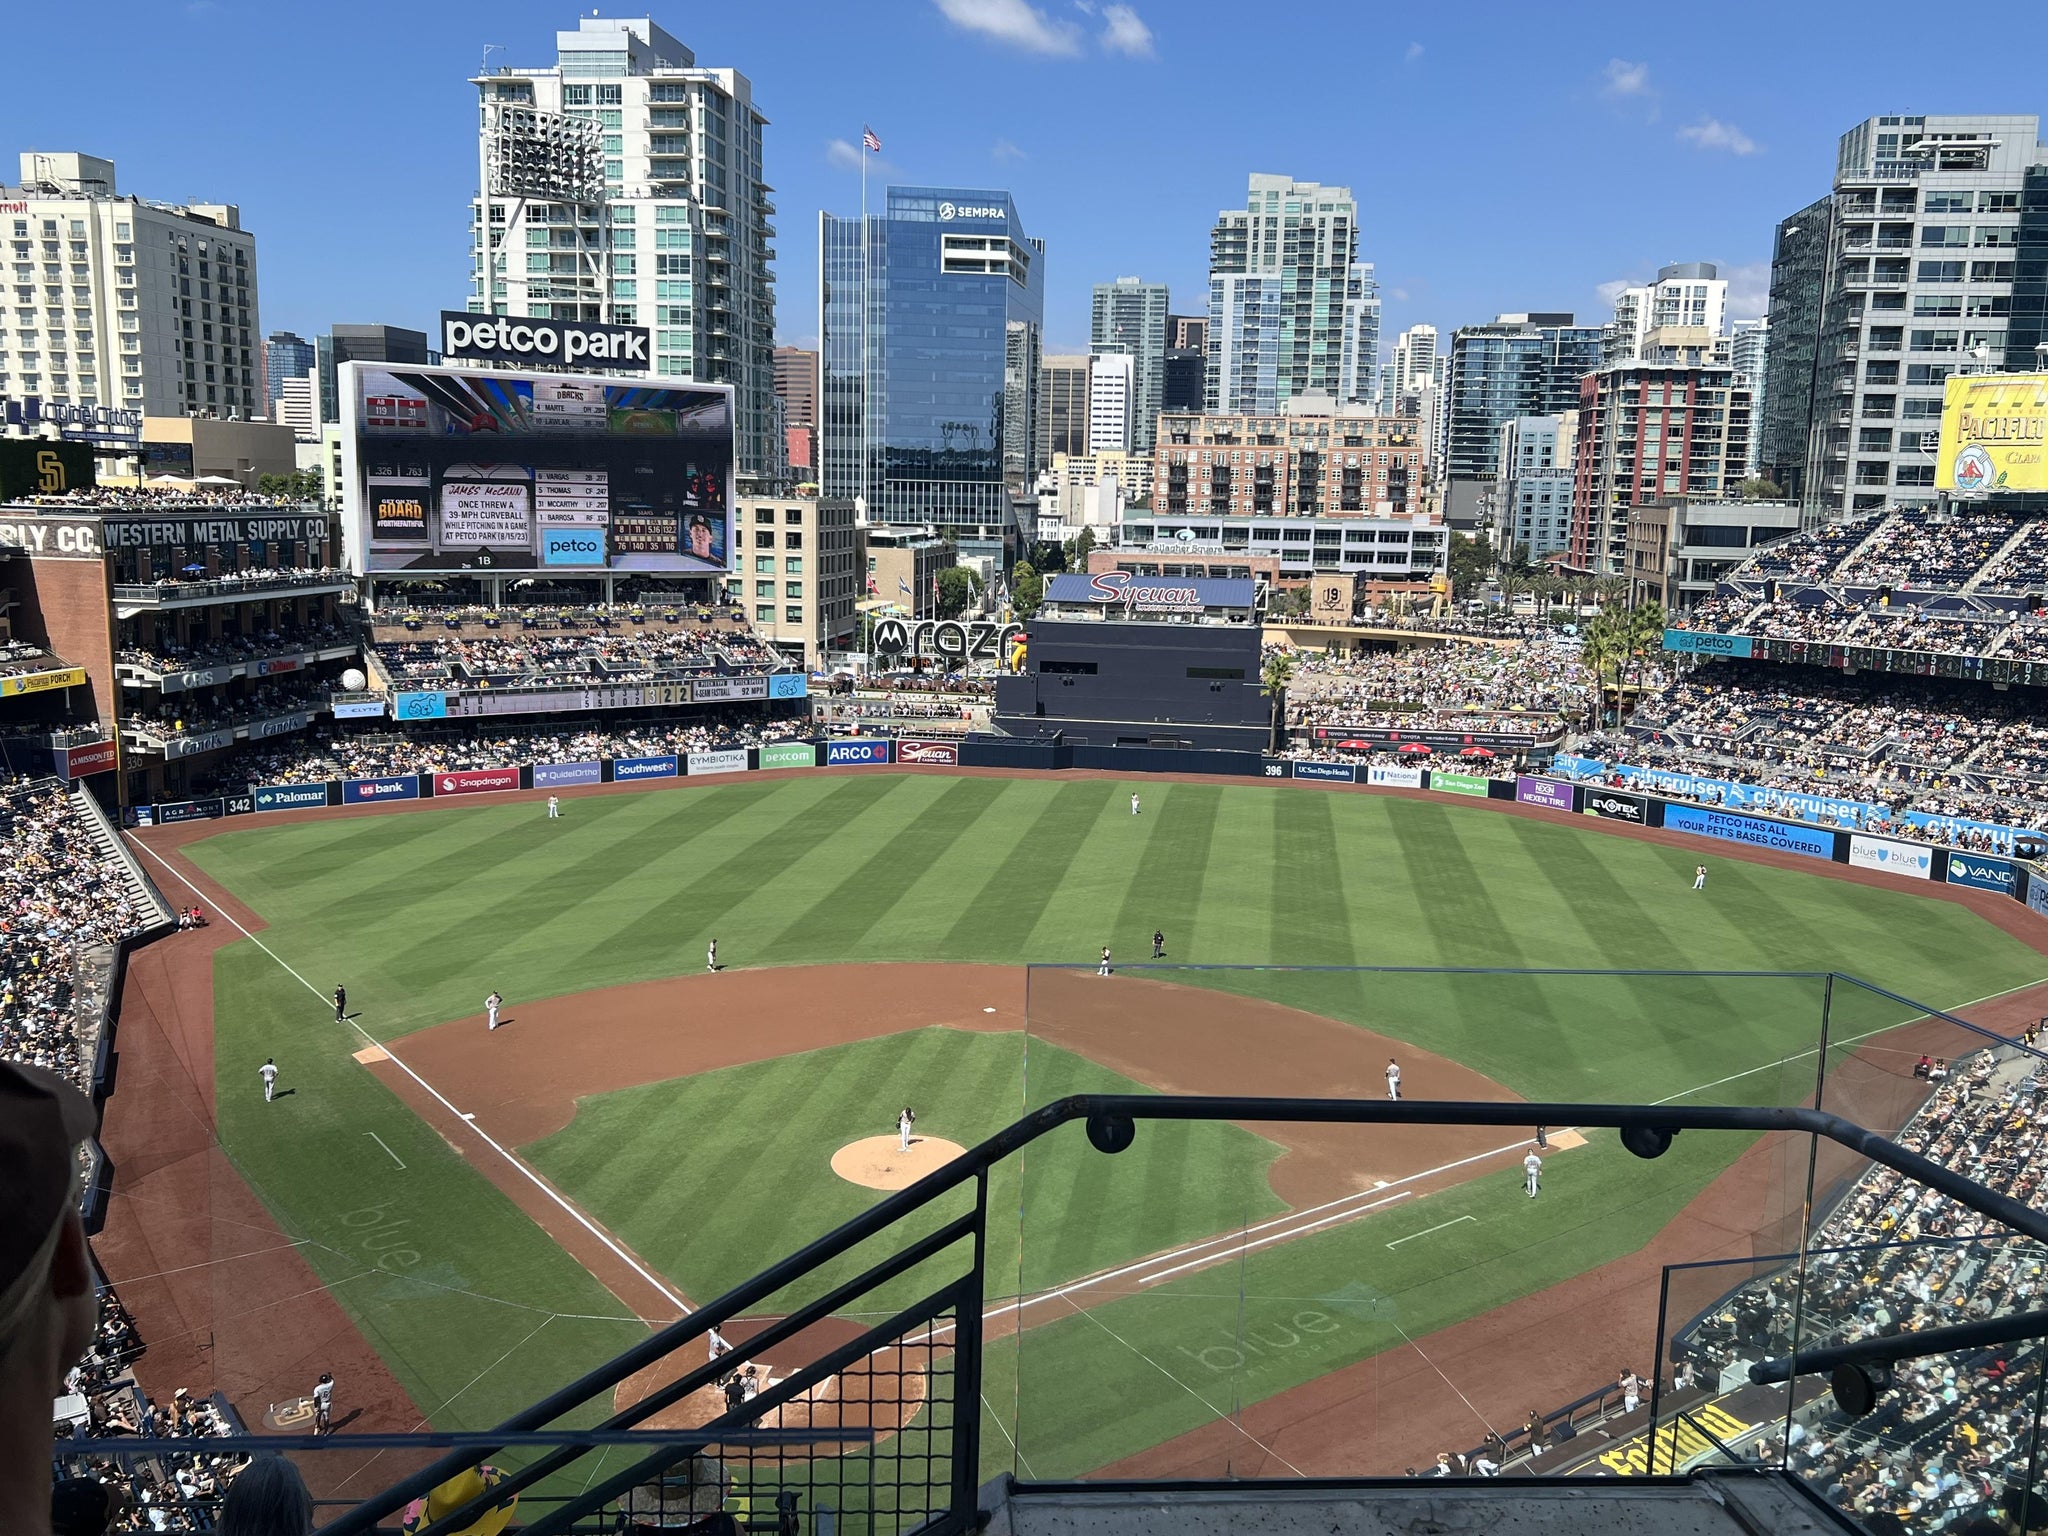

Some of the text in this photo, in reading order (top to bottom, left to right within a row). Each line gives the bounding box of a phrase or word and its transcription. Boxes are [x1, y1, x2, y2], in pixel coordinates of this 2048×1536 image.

[957, 207, 1005, 219] SEMPRA
[446, 317, 646, 363] petco park
[376, 407, 387, 415] 119
[408, 408, 416, 416] 31
[449, 487, 480, 496] JAMES
[547, 500, 578, 508] MCCARTHY
[379, 503, 422, 519] BOARD
[449, 511, 523, 519] 39-MPH CURVEBALL
[466, 522, 496, 530] PITCHING
[497, 522, 503, 530] IN
[505, 522, 509, 530] A
[510, 522, 527, 530] GAME
[104, 519, 328, 546] WESTERN METAL SUPPLY CO.
[445, 532, 528, 541] AT PETCO PARK (8/15/23)
[57, 526, 101, 553] CO.
[551, 539, 597, 554] petco
[1146, 544, 1223, 554] Gallagher Square
[478, 557, 491, 565] 1B
[1088, 570, 1200, 611] Sycuan
[1326, 588, 1338, 600] 19
[912, 620, 1023, 658] razr
[1696, 635, 1733, 650] petco
[1764, 640, 1769, 648] 0
[1804, 644, 1808, 652] 2
[1844, 647, 1849, 656] 0
[1764, 650, 1768, 659] 0
[1804, 655, 1806, 663] 1
[1887, 651, 1892, 660] 0
[1931, 655, 1936, 665] 5
[1844, 658, 1848, 667] 0
[1886, 662, 1891, 671] 2
[1977, 659, 1983, 668] 4
[2012, 662, 2031, 673] P 0
[1930, 666, 1936, 675] 0
[1976, 670, 1981, 680] 0
[1994, 666, 1999, 676] 3
[50, 673, 71, 683] PORCH
[2025, 675, 2030, 684] 2
[649, 688, 687, 703] 3 2 2
[696, 688, 730, 698] 4-SEAM FASTBALL
[751, 687, 763, 695] MPH
[478, 706, 482, 714] 0
[585, 700, 589, 708] 5
[598, 699, 602, 707] 5
[830, 747, 871, 760] ARCO
[901, 743, 951, 762] Sycuan
[127, 755, 142, 770] 336
[690, 754, 745, 765] CYMBIOTIKA
[1558, 757, 1579, 769] city
[618, 762, 667, 775] Southwest
[1265, 765, 1282, 776] 396
[1318, 768, 1332, 776] Diego
[550, 770, 597, 780] QuidelOrtho
[1387, 772, 1417, 780] National
[460, 777, 511, 787] Snapdragon
[1445, 779, 1485, 791] San Diego Zoo
[360, 783, 403, 794] us bank
[276, 792, 324, 803] Palomar
[1524, 793, 1566, 807] NEXEN TIRE
[230, 799, 250, 812] 342
[1593, 799, 1639, 815] EVOTEK
[1754, 791, 1859, 820] citycruises
[1708, 814, 1787, 836] PETCO HAS ALL
[1678, 820, 1821, 854] YOUR PET'S BASES COVERED
[1853, 845, 1876, 857] blue
[1892, 851, 1917, 865] blue
[338, 1202, 421, 1270] blue
[1176, 1310, 1340, 1374] blue
